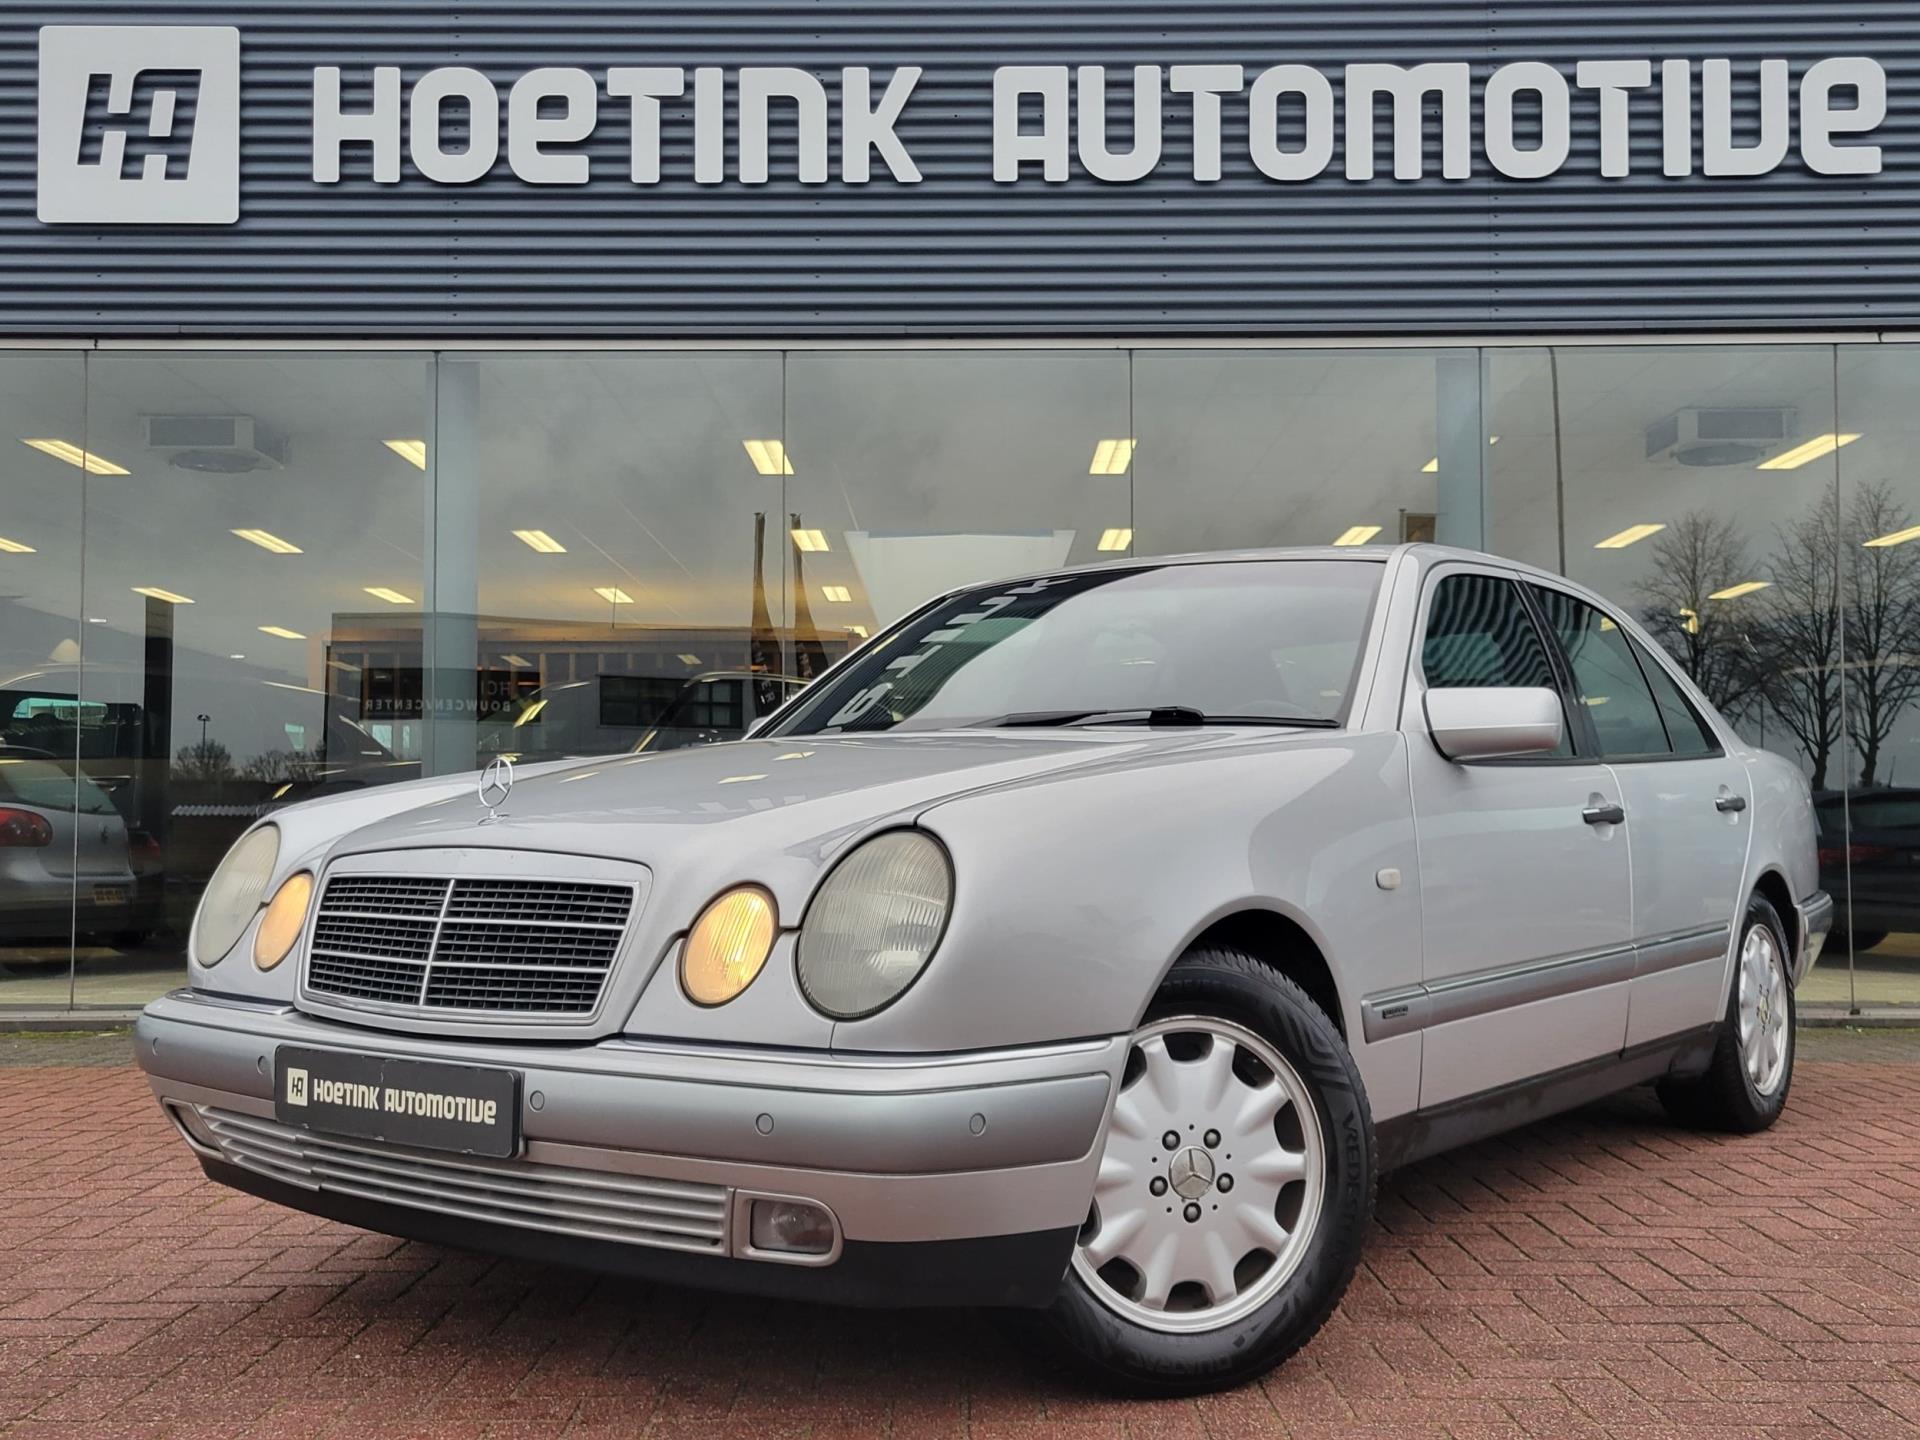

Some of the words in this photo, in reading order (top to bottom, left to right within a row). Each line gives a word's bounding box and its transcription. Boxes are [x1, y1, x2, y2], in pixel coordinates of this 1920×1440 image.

[312, 66, 923, 184] HOETINK
[992, 57, 1888, 182] AUTOMOTIVE
[313, 1078, 380, 1110] HOETINK
[384, 1088, 497, 1125] AUTOMOTIVE
